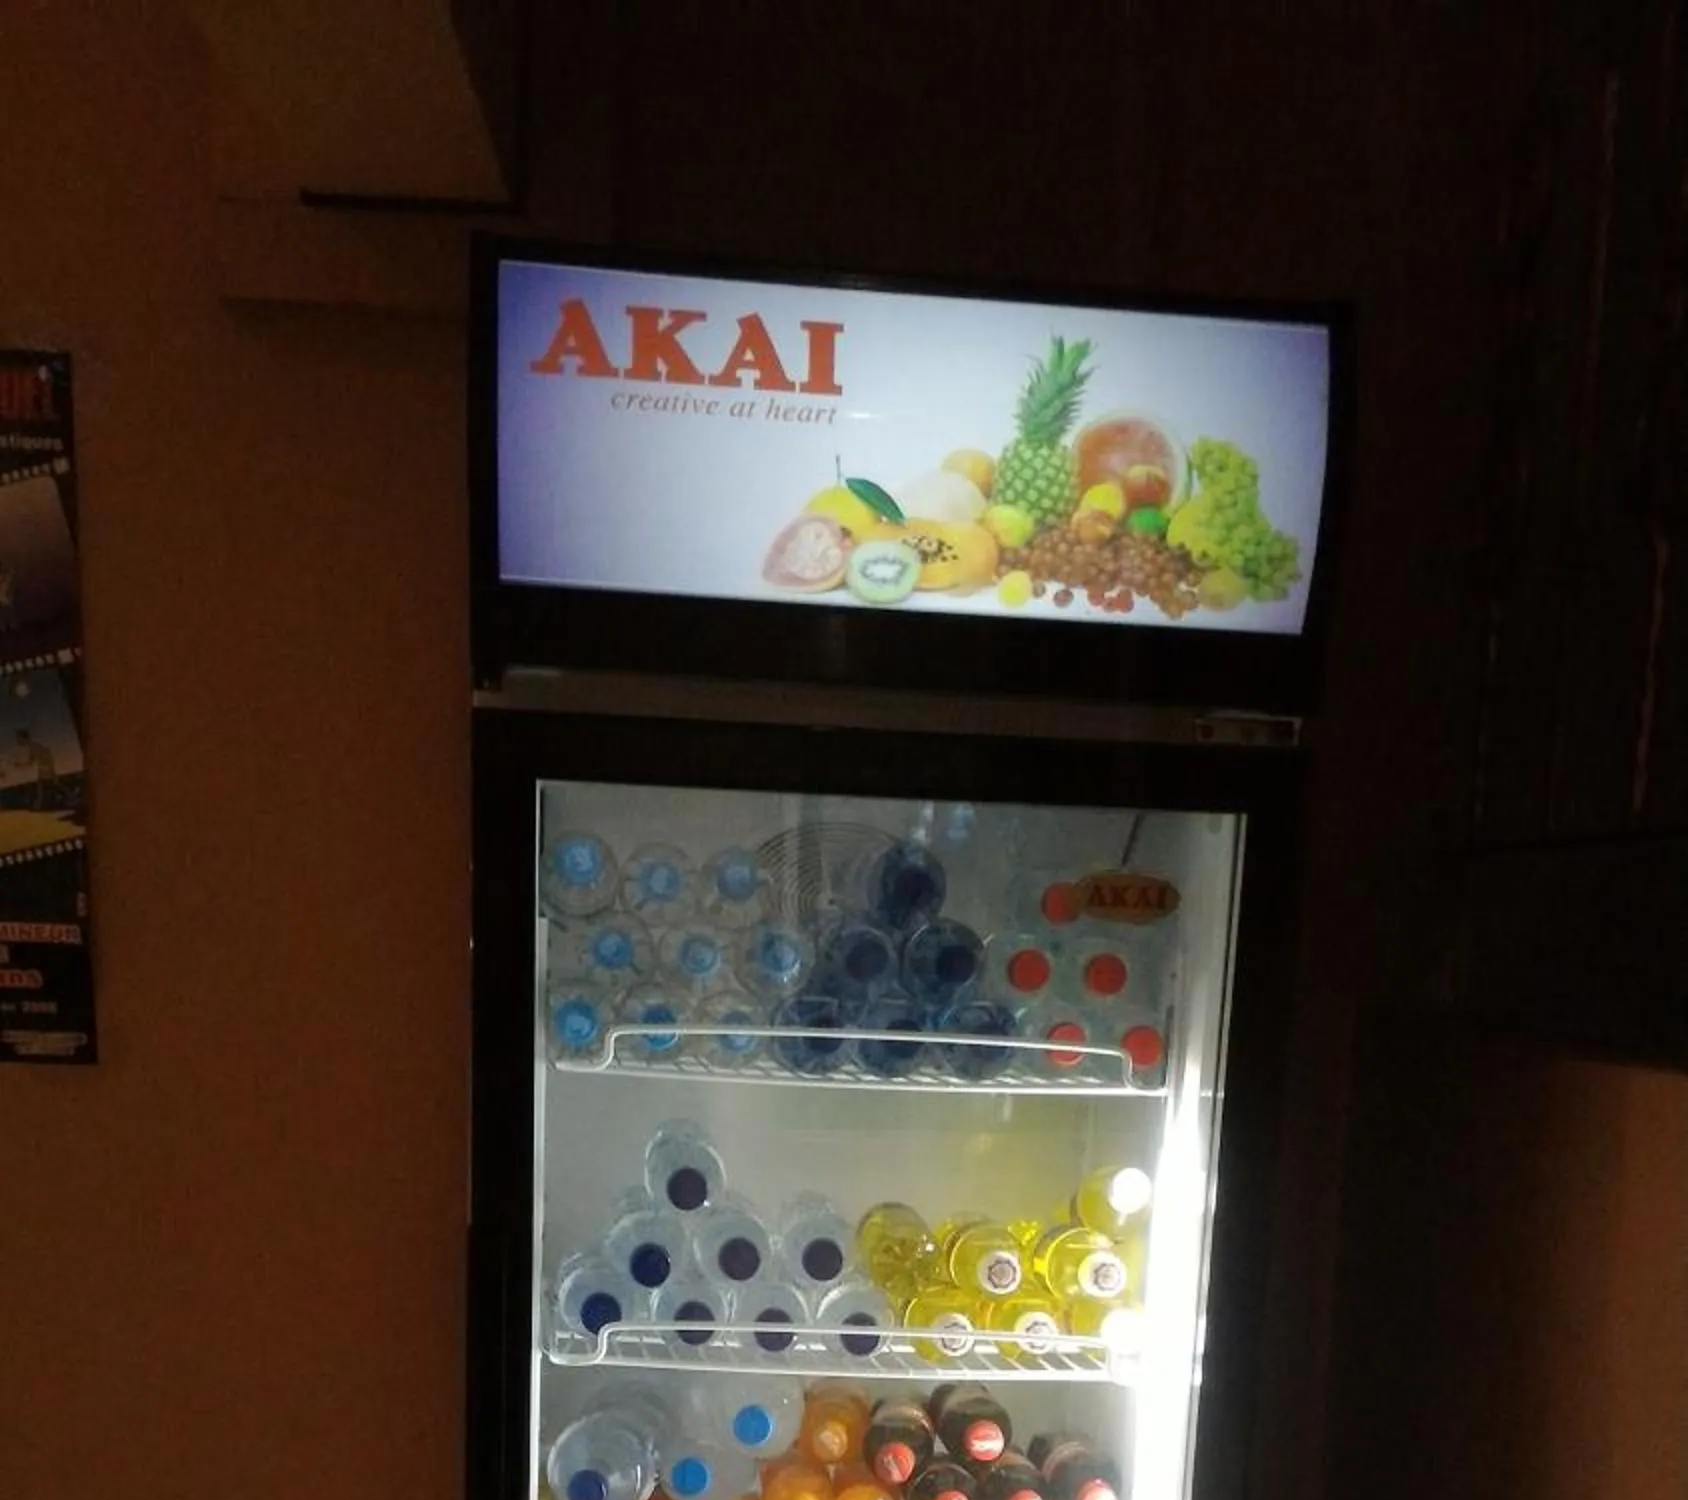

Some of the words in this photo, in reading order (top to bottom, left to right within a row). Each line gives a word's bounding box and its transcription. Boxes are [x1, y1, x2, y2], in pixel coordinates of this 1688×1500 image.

[529, 297, 845, 396] AKAI
[610, 389, 719, 417] creative
[729, 396, 756, 419] at
[765, 398, 838, 425] heart
[1087, 883, 1167, 910] AKAI
